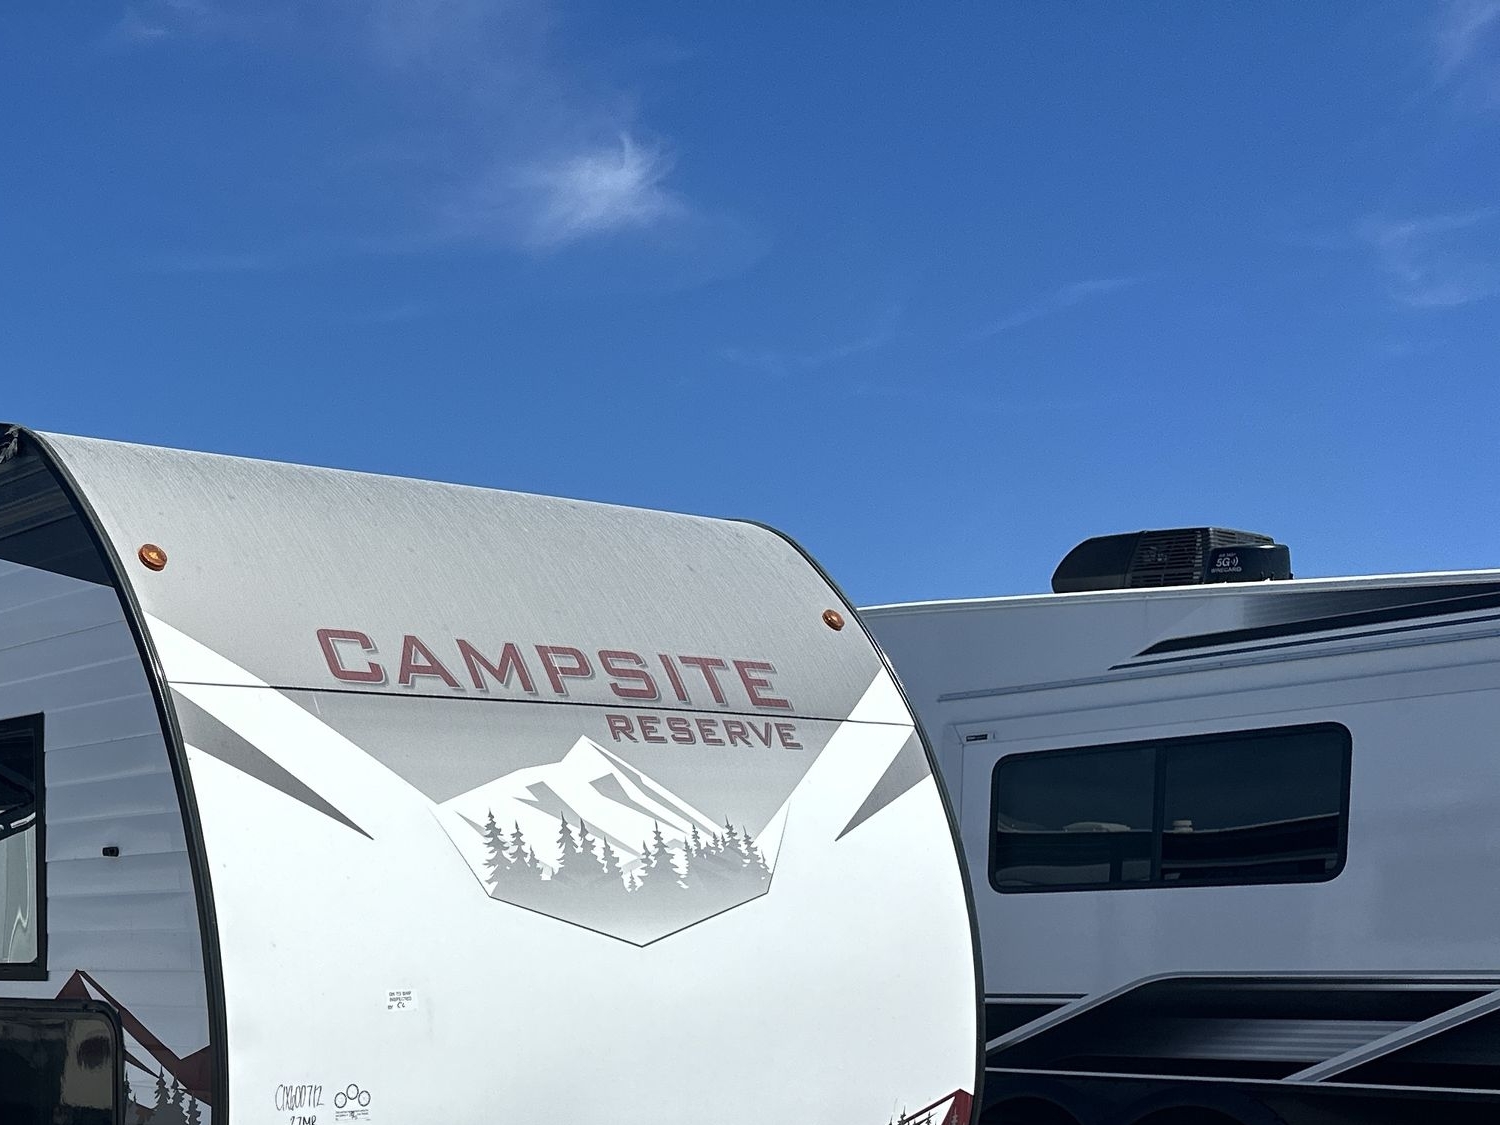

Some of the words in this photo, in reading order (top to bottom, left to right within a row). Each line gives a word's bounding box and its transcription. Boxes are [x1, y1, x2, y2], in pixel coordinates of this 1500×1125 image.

[1216, 557, 1230, 567] 5G
[316, 628, 794, 710] CAMPSITE
[604, 713, 803, 750] RESERVE
